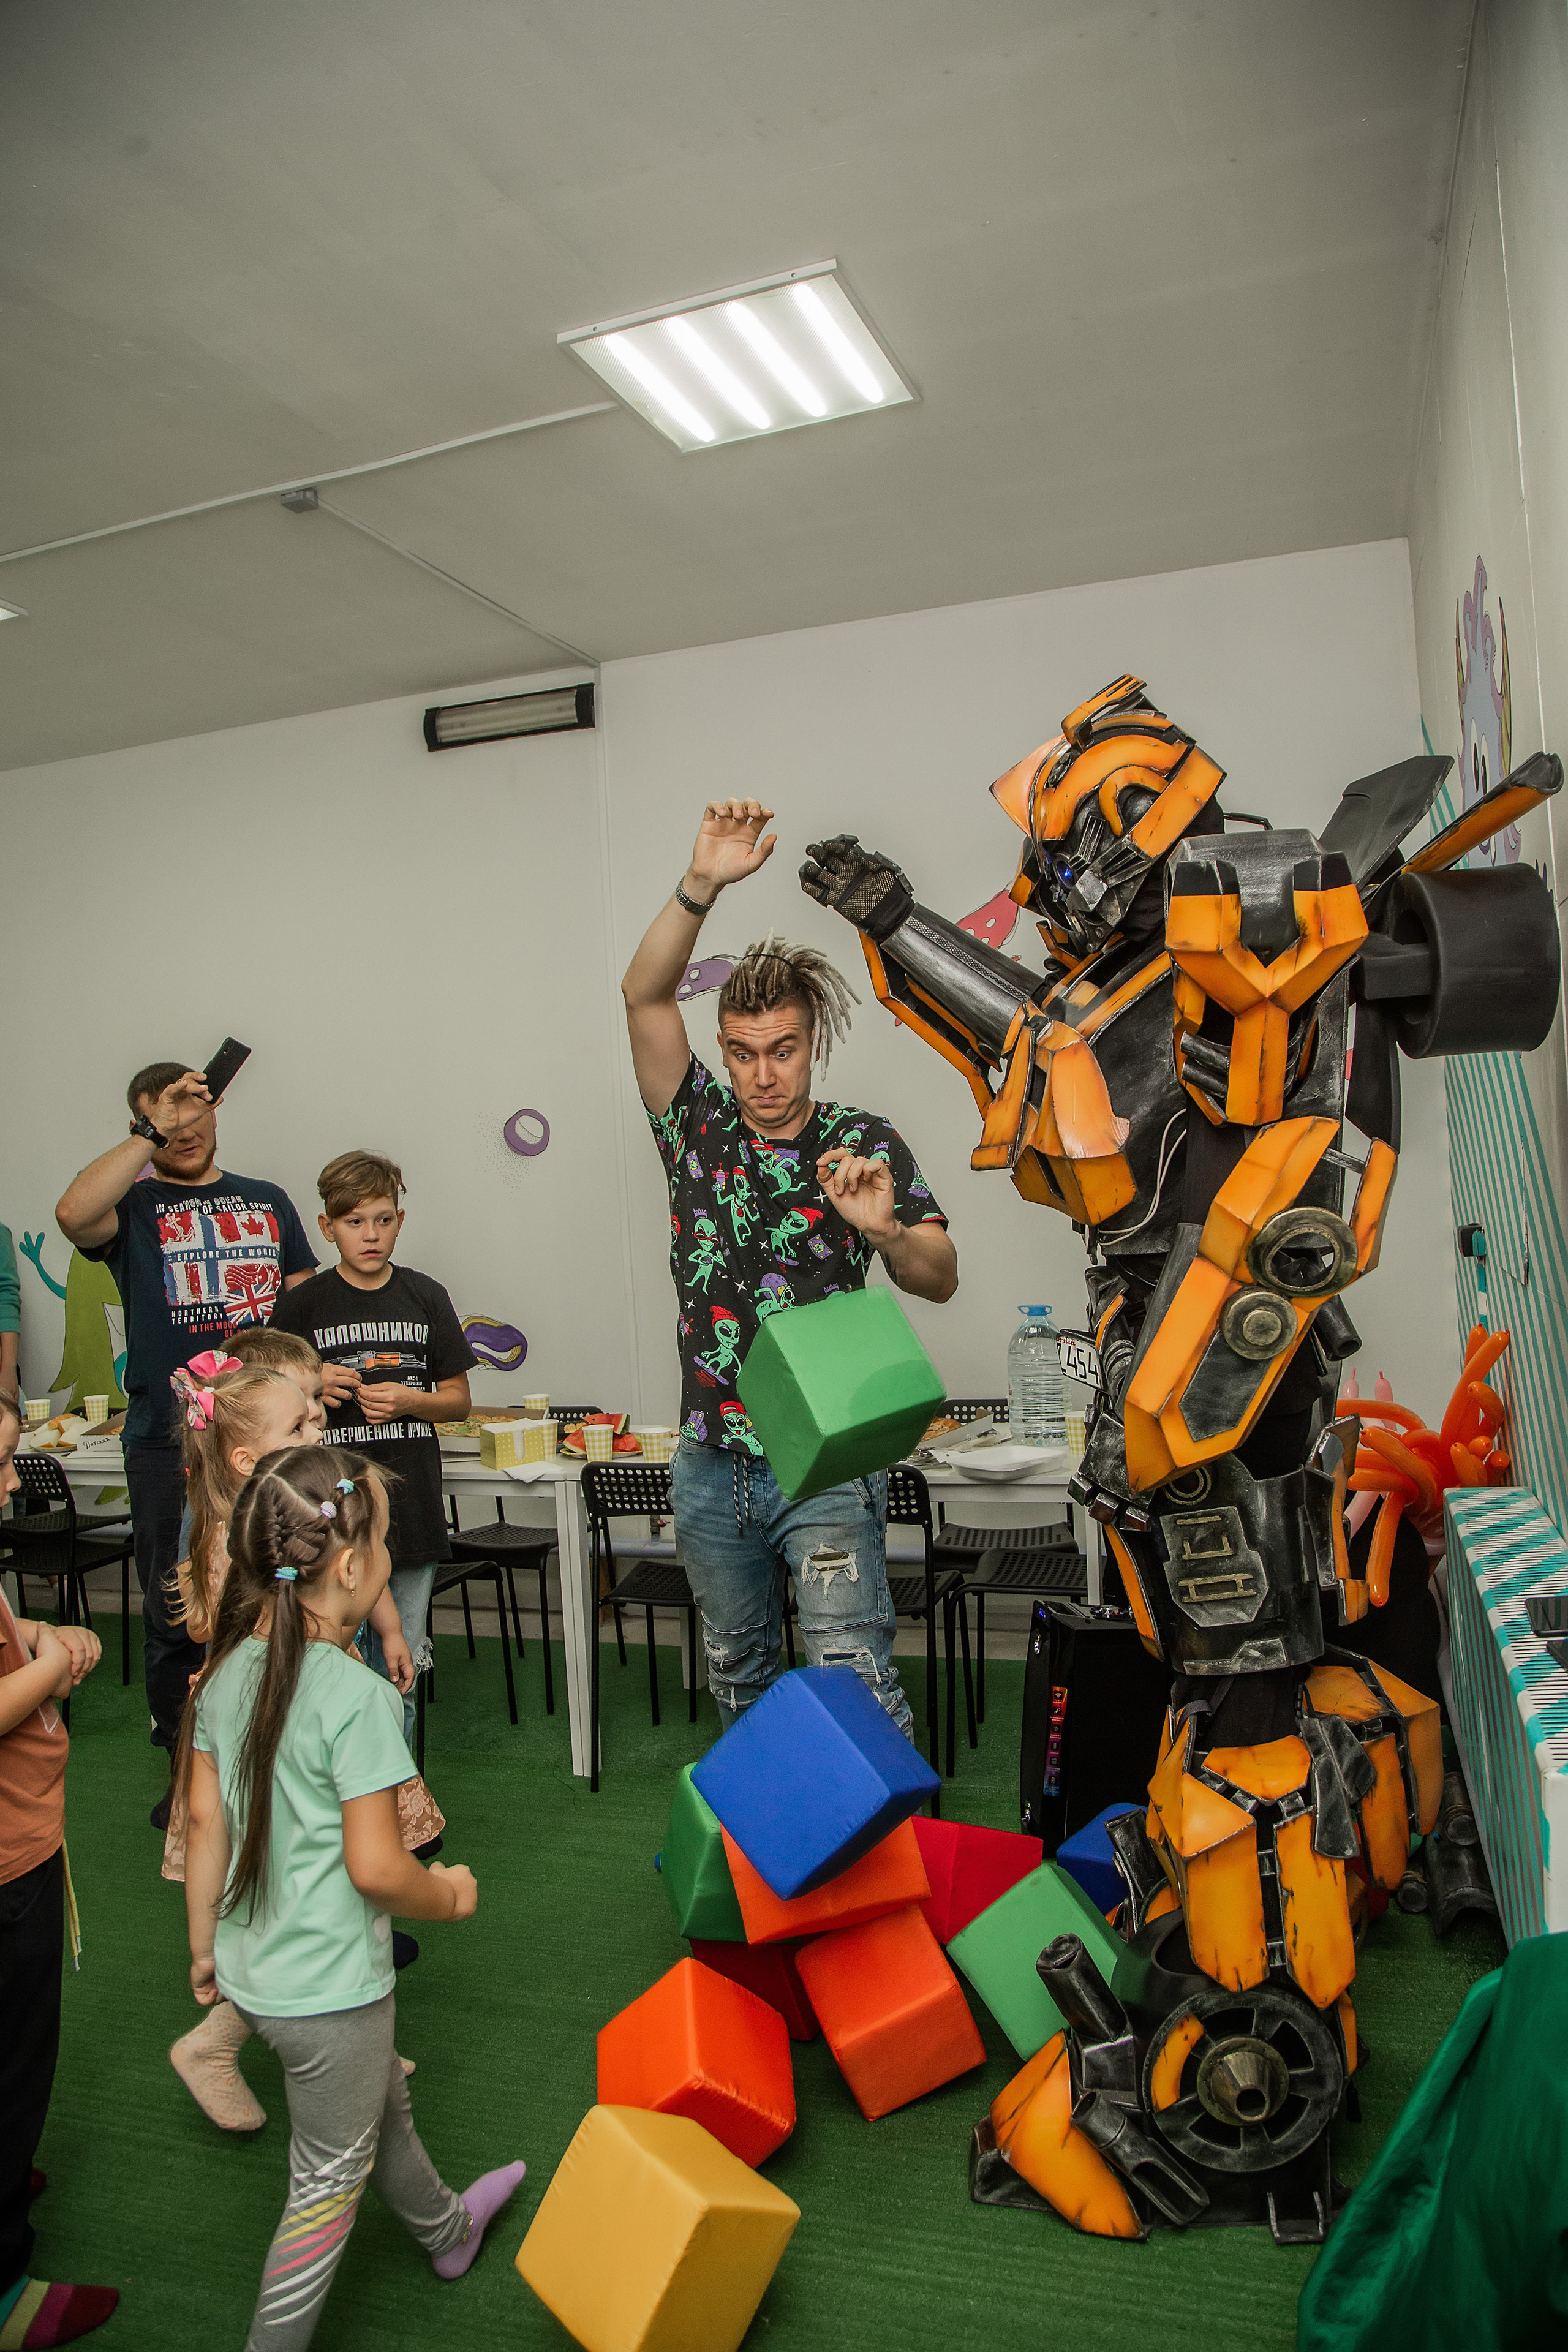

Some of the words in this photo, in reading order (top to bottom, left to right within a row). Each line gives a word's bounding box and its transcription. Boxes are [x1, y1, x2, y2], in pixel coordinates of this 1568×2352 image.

[213, 1195, 243, 1205] OCEAN
[156, 1203, 165, 1213] IN
[202, 1204, 213, 1215] OF
[216, 1203, 247, 1212] SAILOR
[249, 1202, 273, 1211] SPIRIT
[177, 1250, 220, 1261] EXPLORE
[225, 1249, 243, 1257] THE
[172, 1306, 219, 1317] NORTHERN
[172, 1313, 223, 1325] TERRITORY
[189, 1325, 197, 1333] IN
[199, 1322, 214, 1332] THE
[313, 1322, 429, 1350] КАЛАШНИКОВ
[1056, 1337, 1076, 1346] ornia
[319, 1423, 405, 1446] ОВЕРШЕННОЕ
[407, 1422, 432, 1439] ОРУЖИЕ
